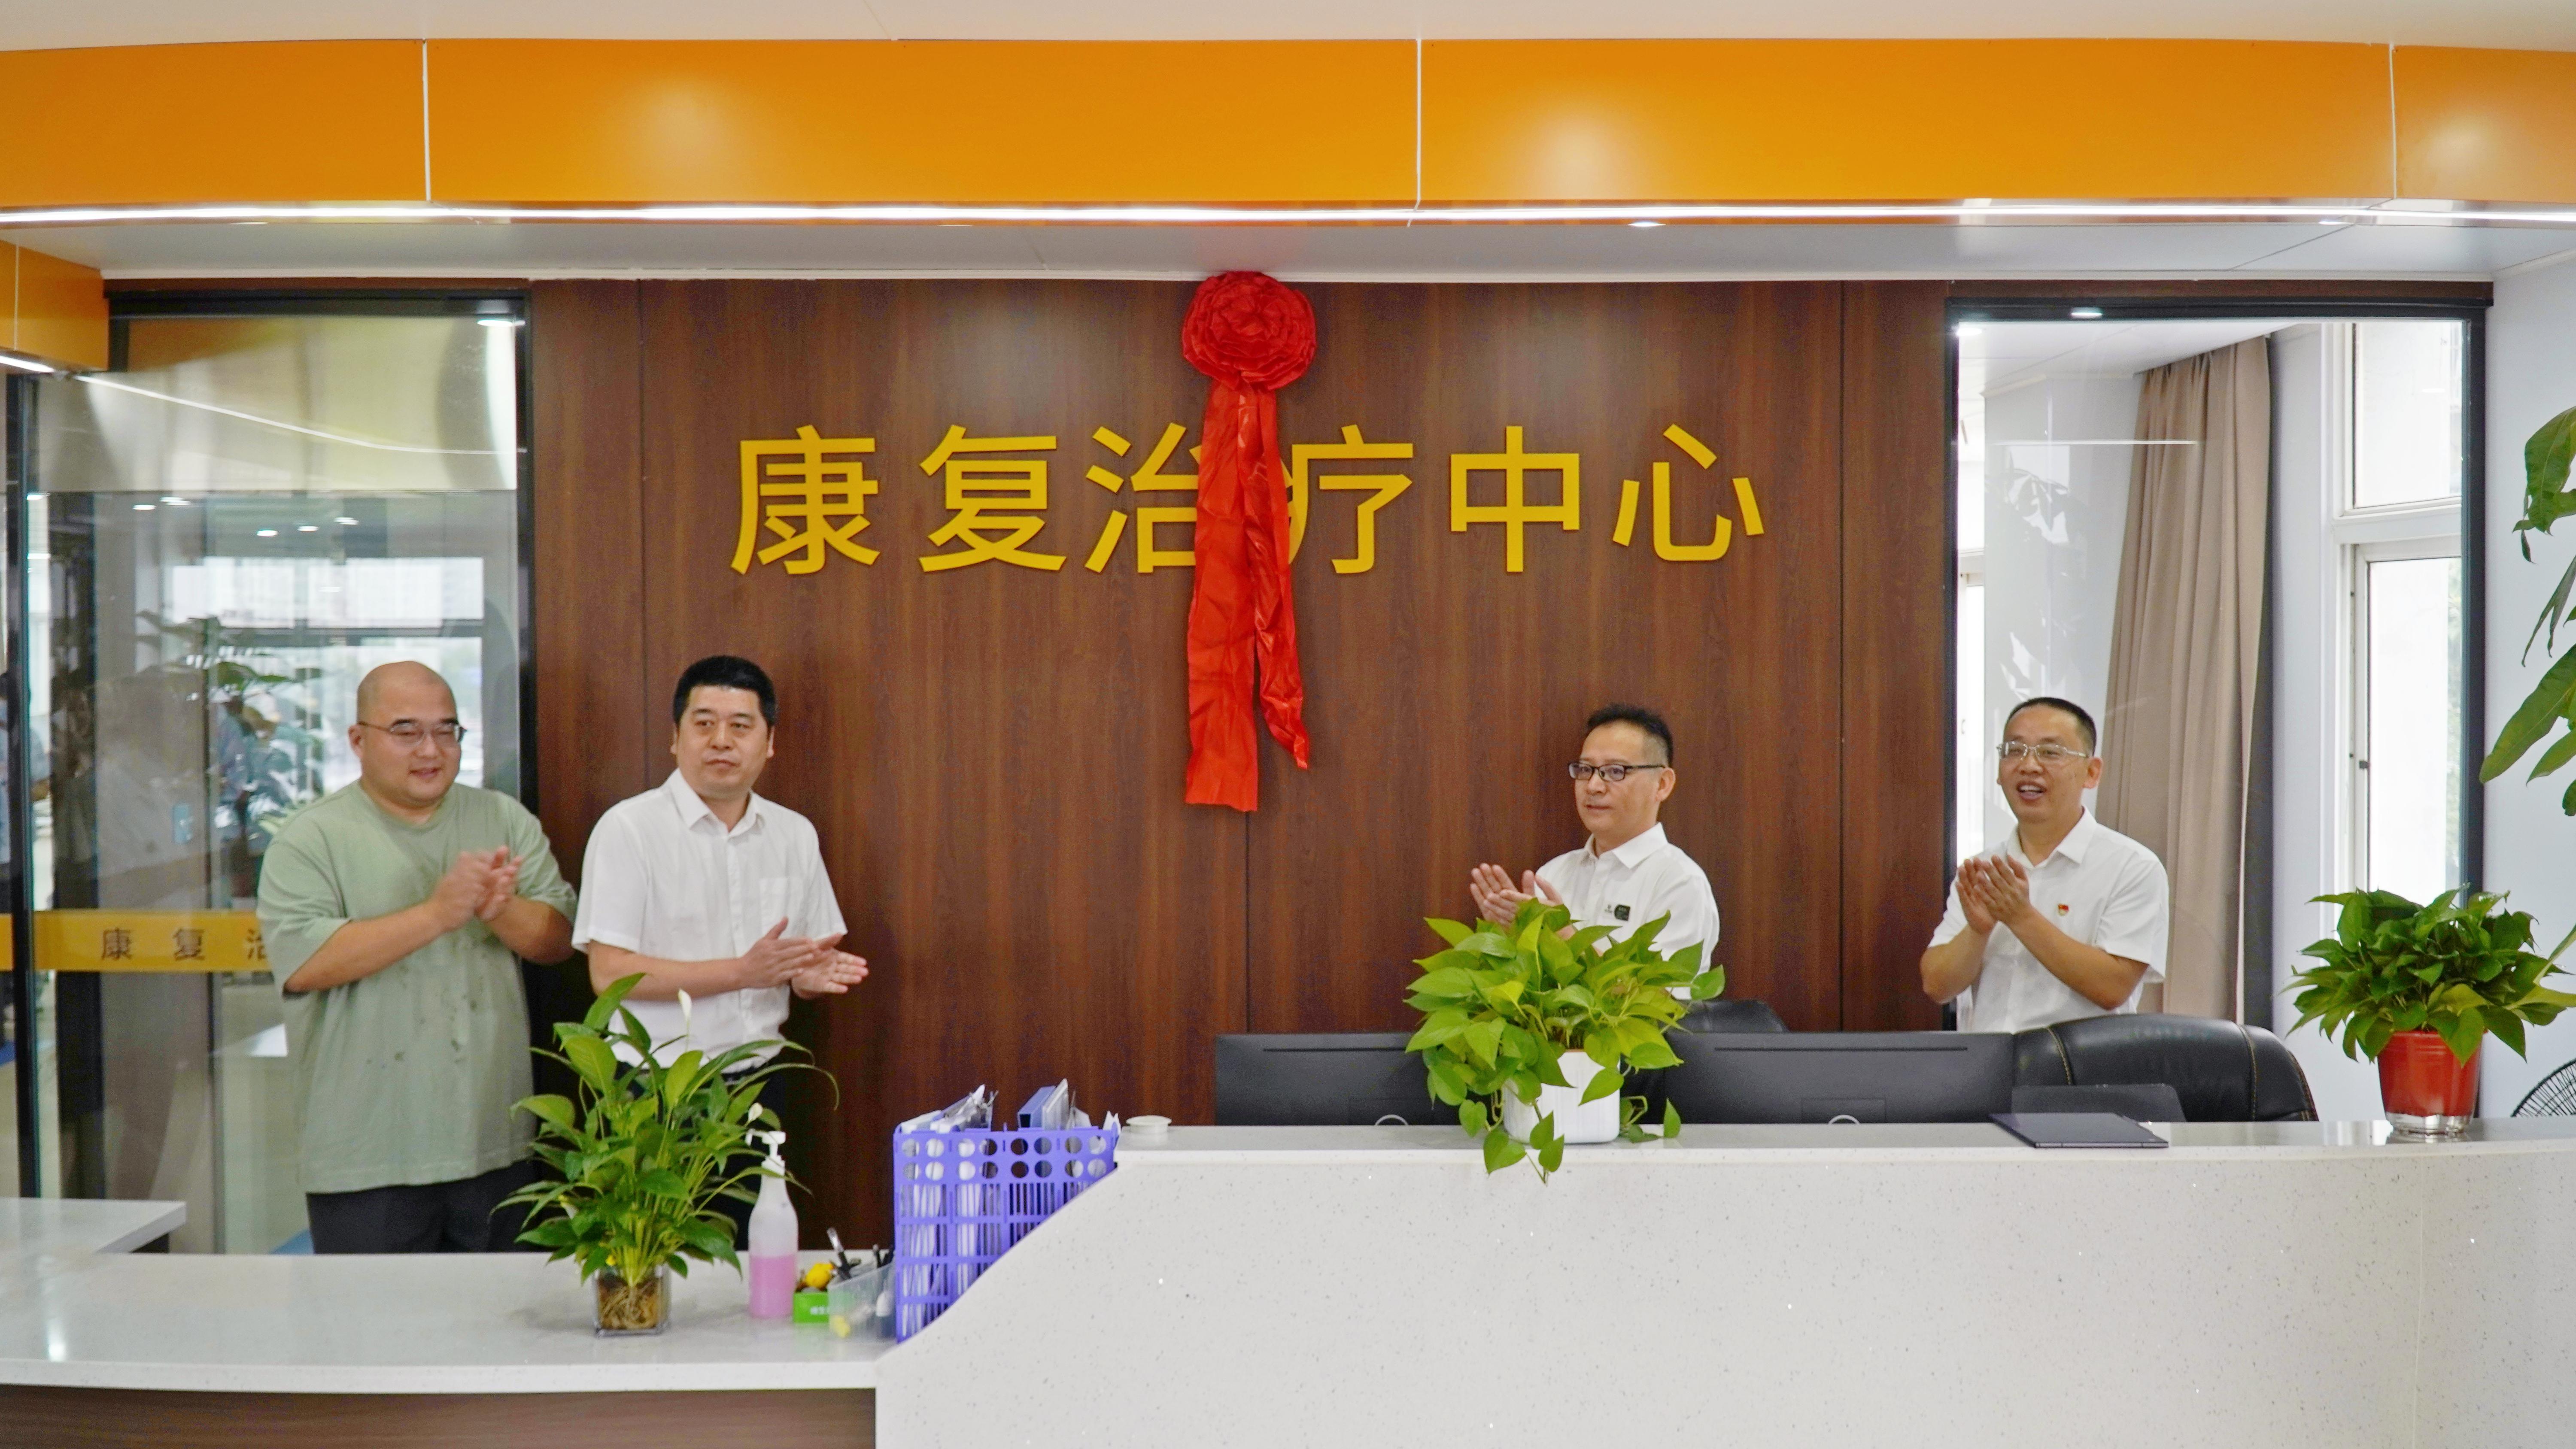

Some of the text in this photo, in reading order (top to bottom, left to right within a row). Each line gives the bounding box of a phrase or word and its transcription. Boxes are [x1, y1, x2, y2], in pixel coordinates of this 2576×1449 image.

[730, 423, 1765, 575] 康复治疗中心
